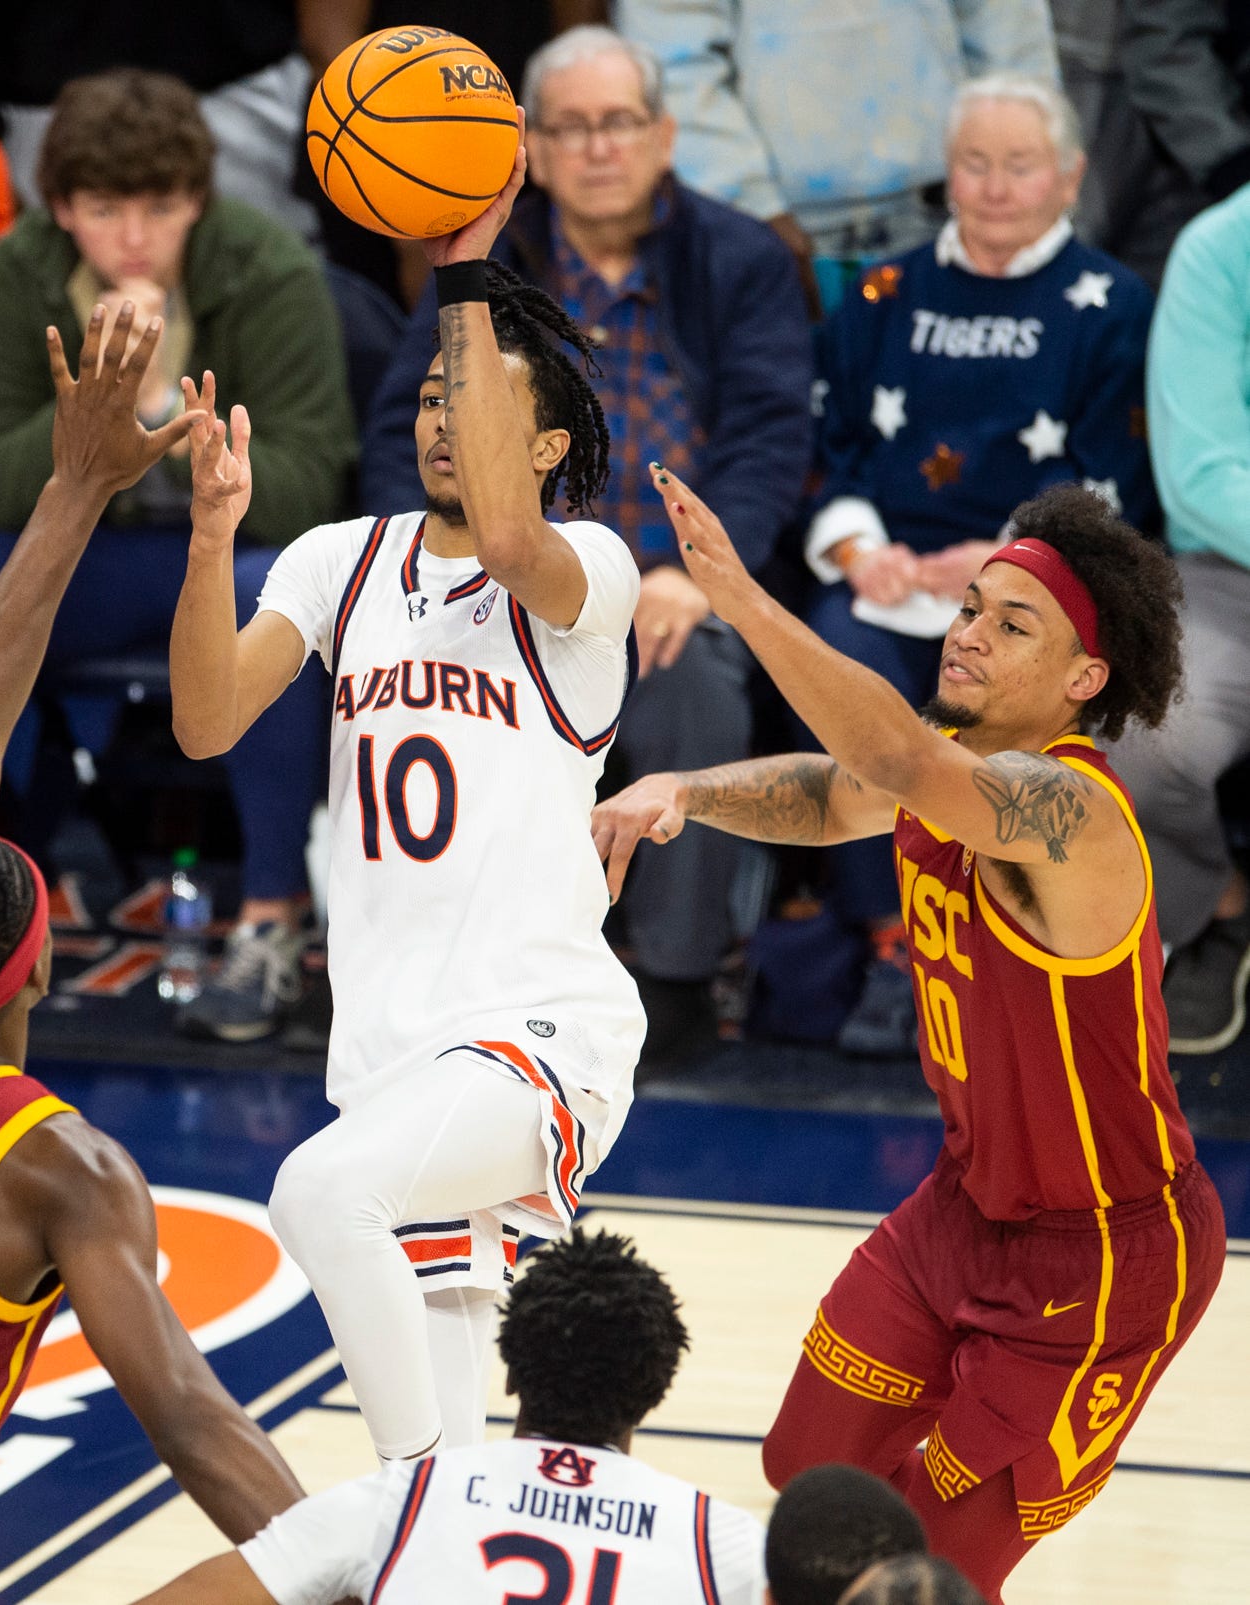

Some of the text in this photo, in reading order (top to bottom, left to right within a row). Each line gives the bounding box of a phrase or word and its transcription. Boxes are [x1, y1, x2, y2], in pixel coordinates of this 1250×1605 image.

[438, 63, 513, 99] NCAA
[910, 308, 1045, 360] TIGERS
[335, 659, 521, 731] AUBURN
[357, 733, 459, 864] 10
[913, 961, 968, 1083] 10
[466, 1475, 658, 1541] C. JOHNSON
[477, 1530, 624, 1605] 31
